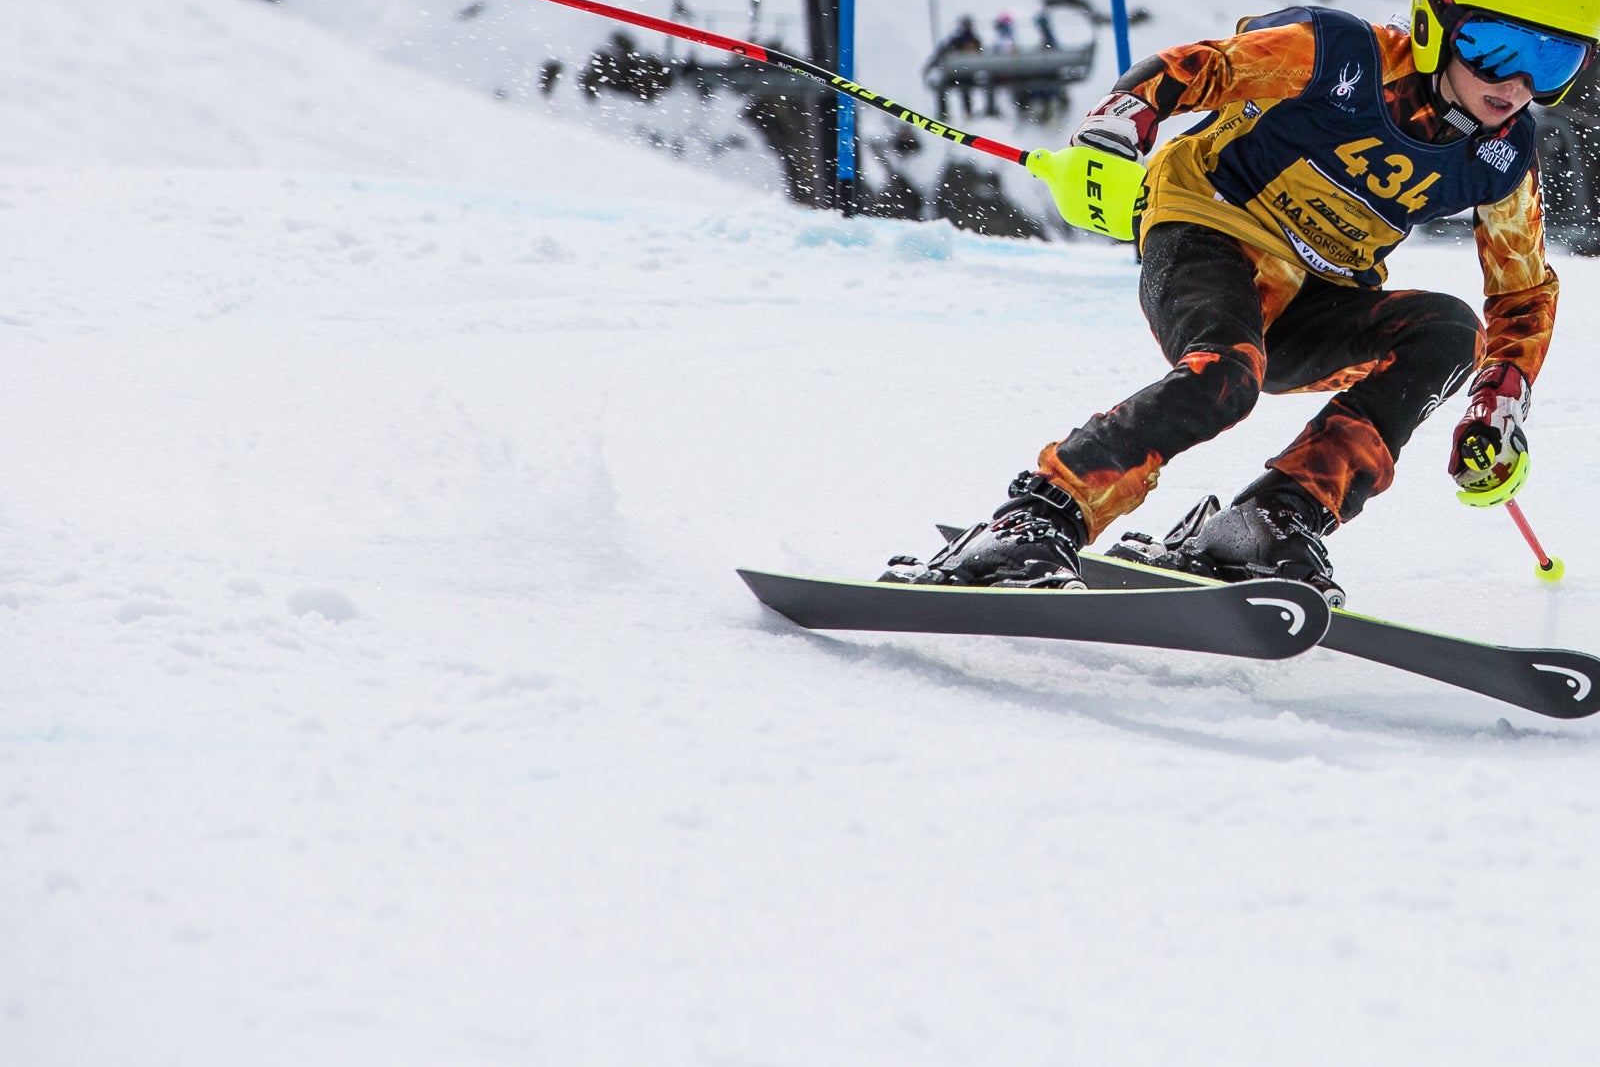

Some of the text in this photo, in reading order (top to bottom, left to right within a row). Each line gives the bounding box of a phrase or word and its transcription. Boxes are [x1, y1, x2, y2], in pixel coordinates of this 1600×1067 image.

[899, 110, 966, 144] LEKI
[1203, 114, 1246, 143] Liber
[1476, 145, 1511, 174] PROTEIN
[1482, 139, 1517, 163] OCKIN
[1334, 137, 1442, 214] 434
[1087, 159, 1110, 233] LEKI
[1302, 246, 1332, 273] VALLE
[1472, 445, 1489, 470] LEKI
